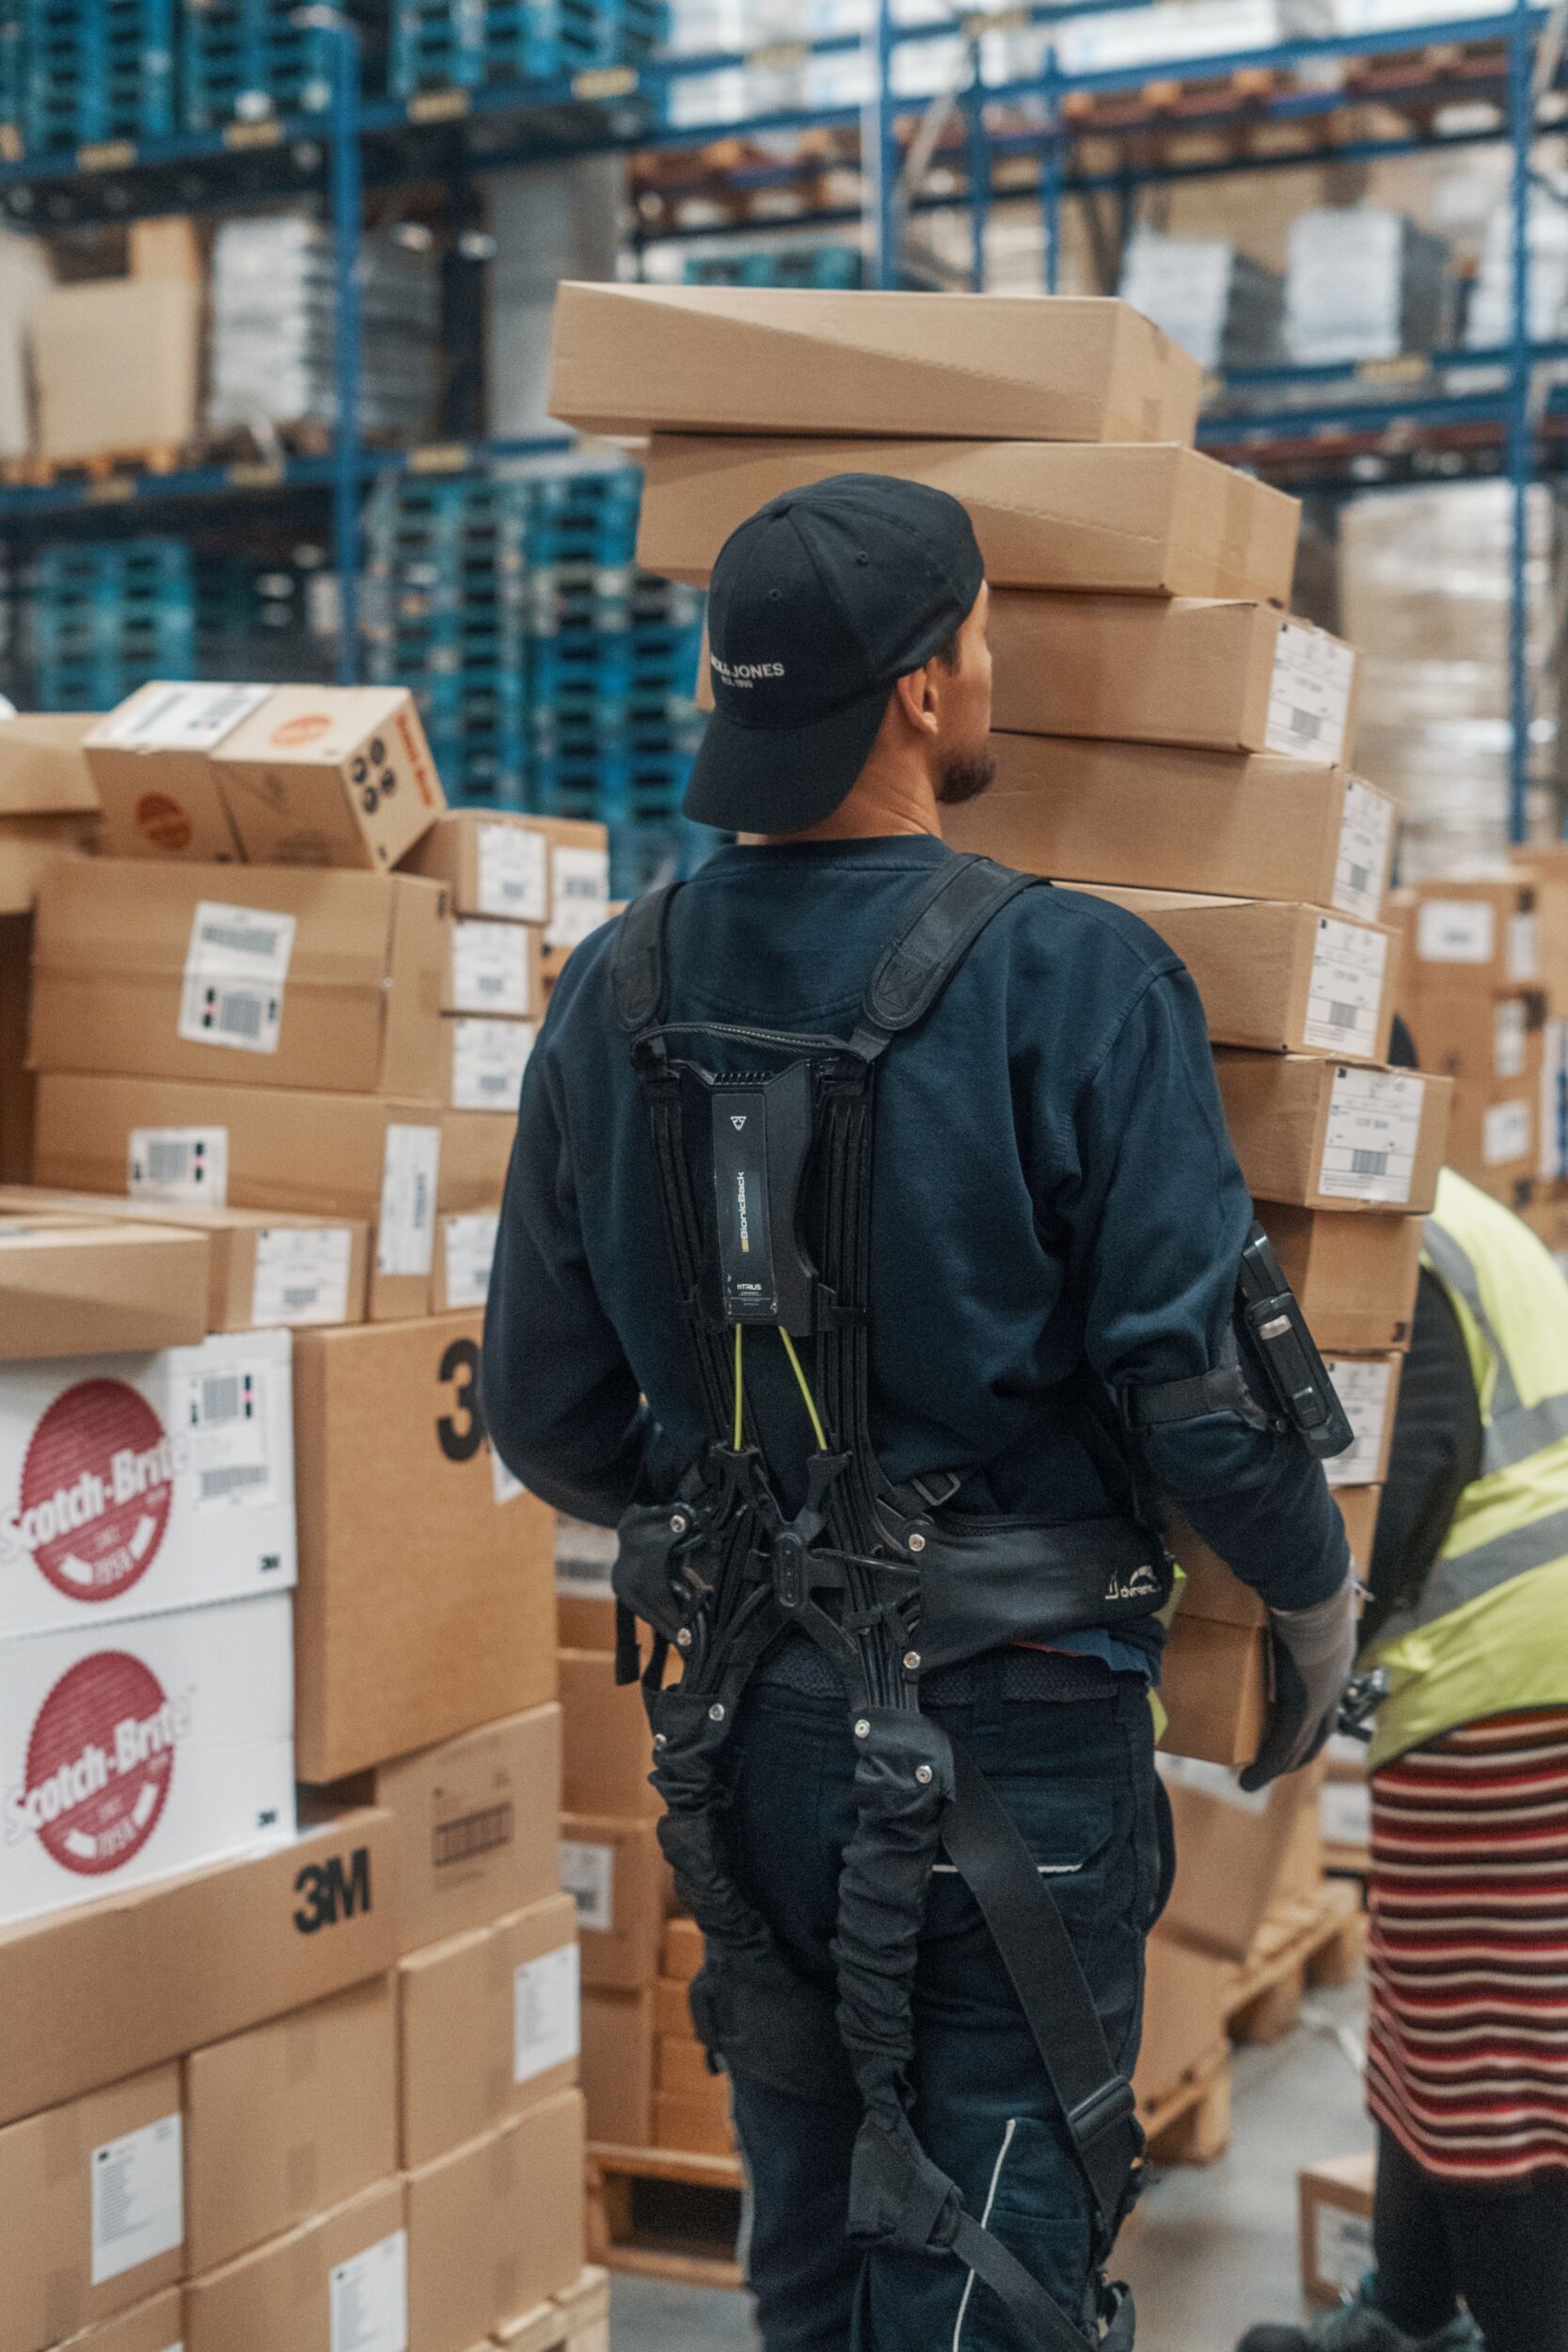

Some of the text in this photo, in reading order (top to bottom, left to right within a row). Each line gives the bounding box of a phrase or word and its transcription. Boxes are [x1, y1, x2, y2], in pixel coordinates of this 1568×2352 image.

[733, 662, 785, 678] JONES
[736, 1171, 749, 1239] BionicBack
[436, 1338, 490, 1464] 3
[1, 1435, 188, 1563] Scotch-Brite
[6, 1700, 192, 1846] Scotch-Brite
[293, 1847, 371, 1933] 3M
